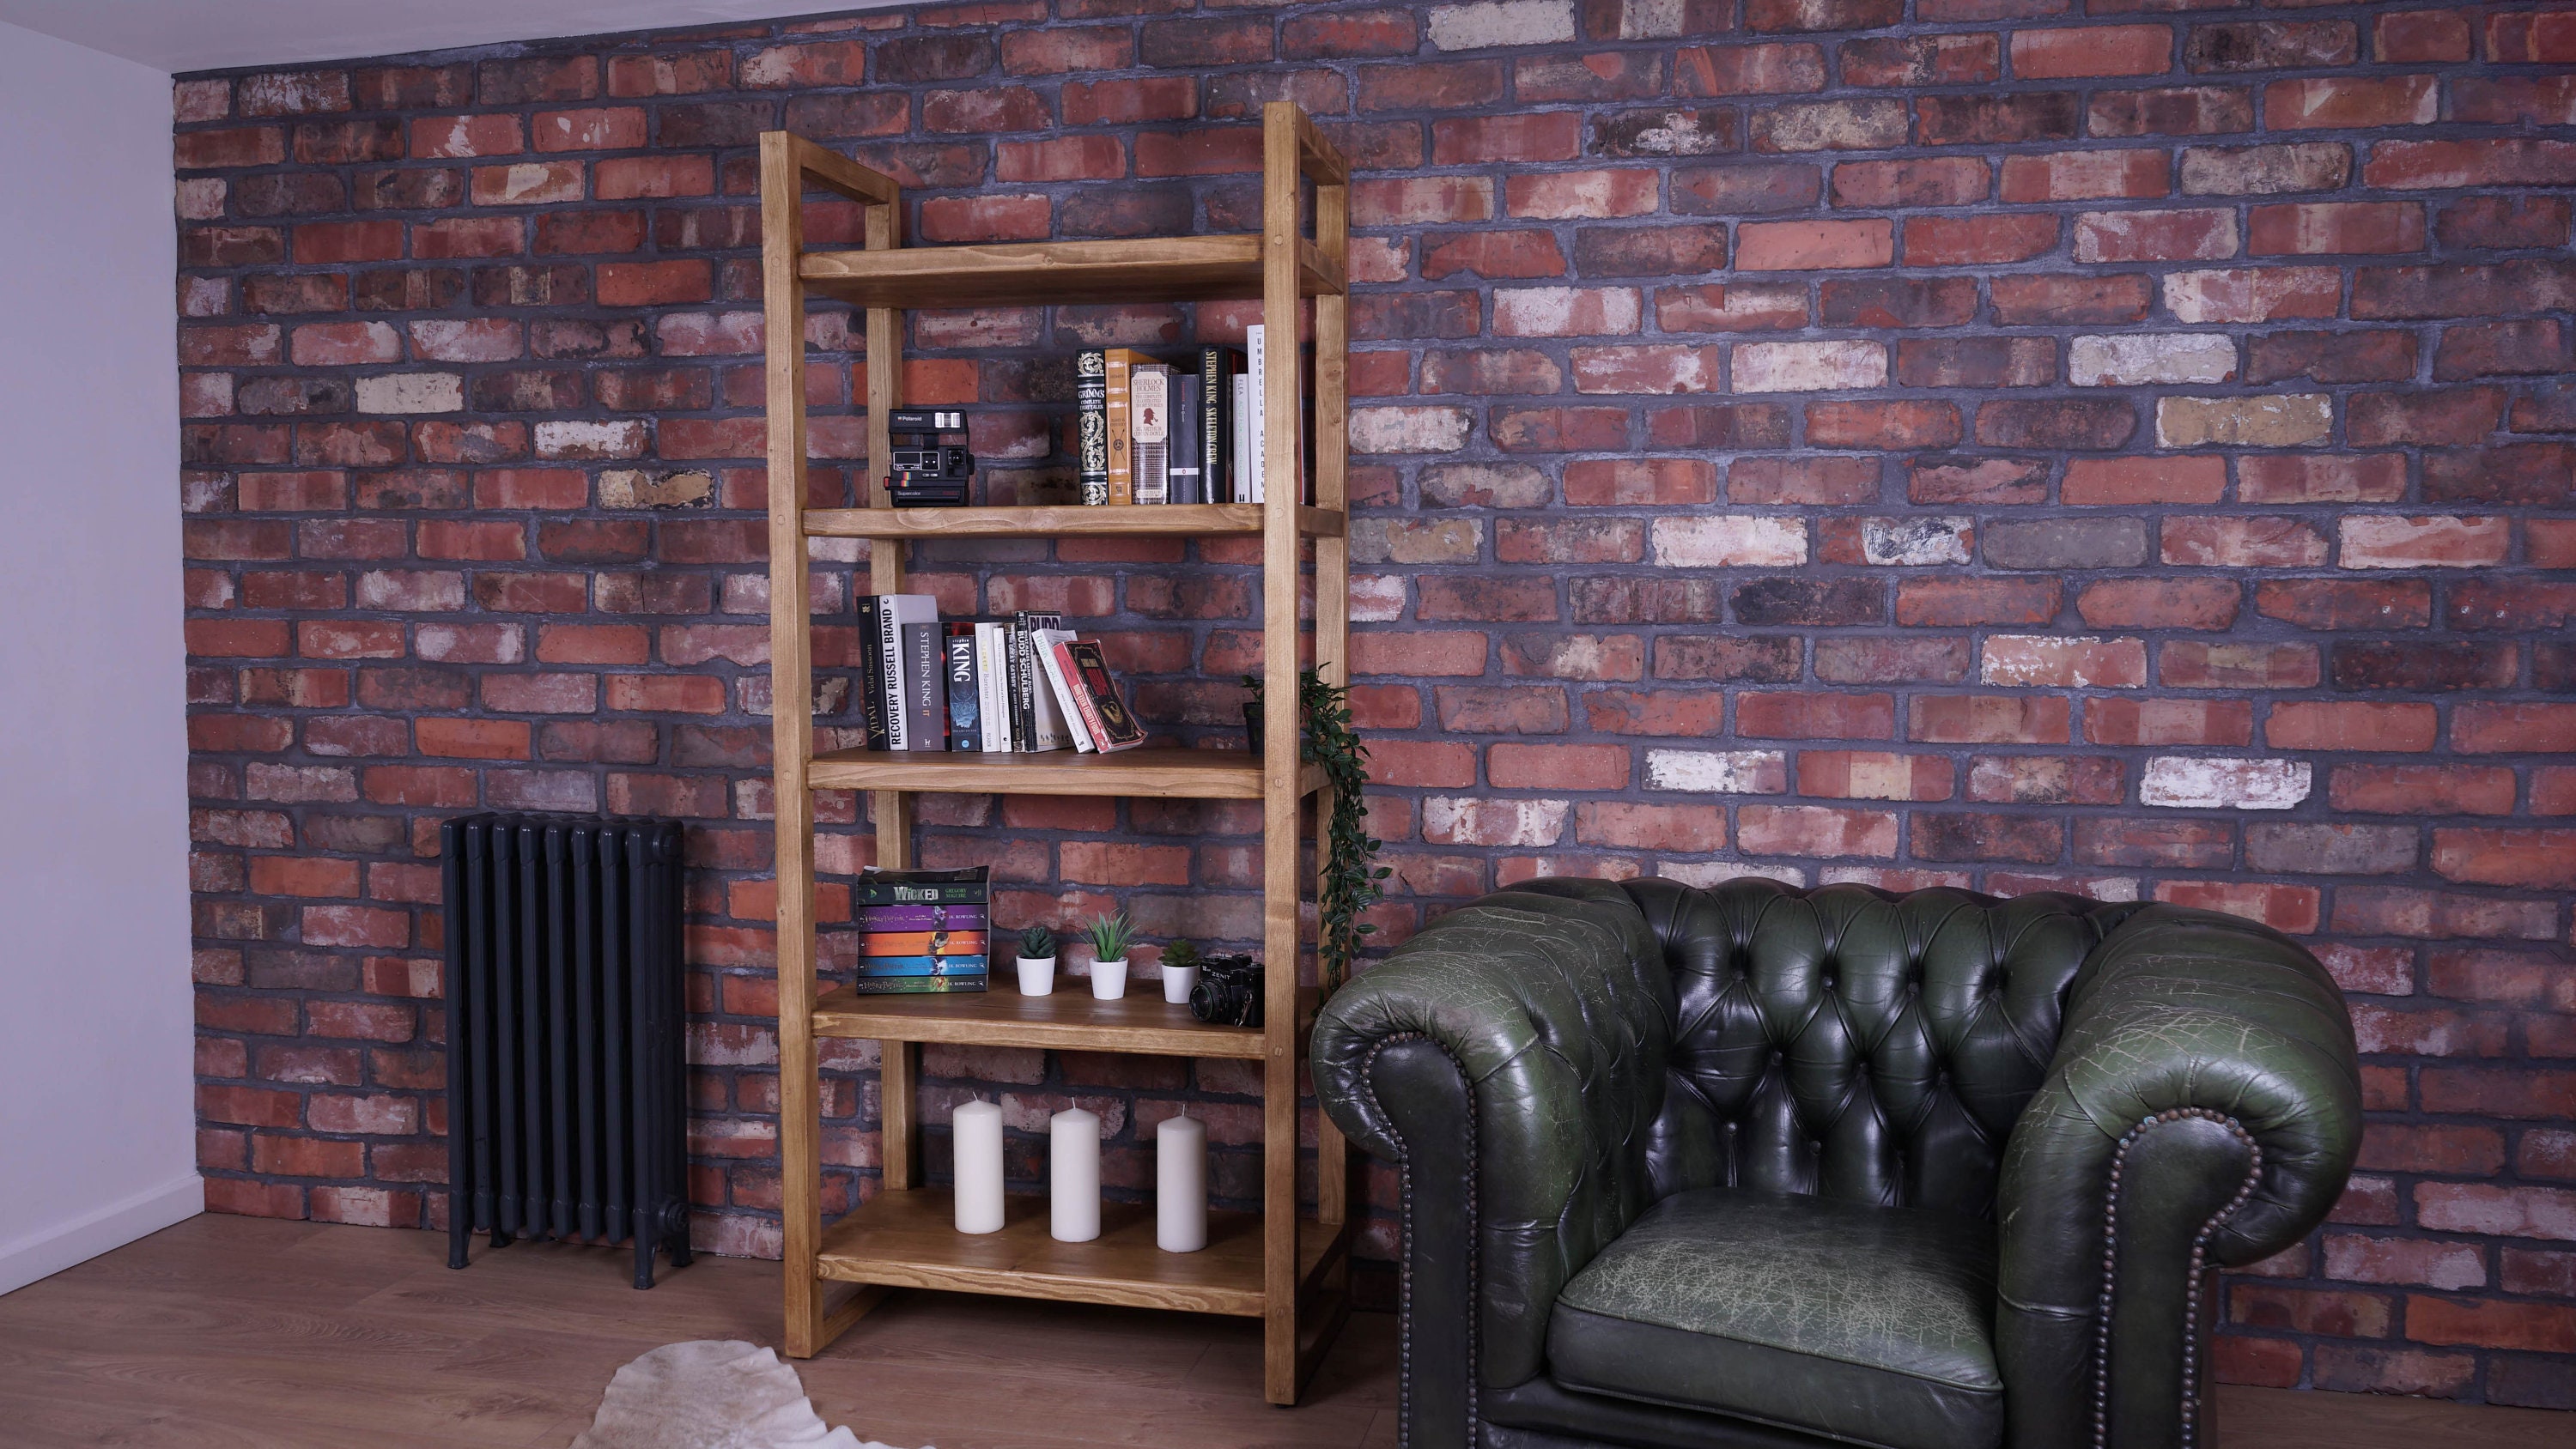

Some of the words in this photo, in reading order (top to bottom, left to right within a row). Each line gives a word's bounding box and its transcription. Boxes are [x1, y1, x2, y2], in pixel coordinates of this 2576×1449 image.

[1206, 351, 1218, 385] STEPHEN
[1206, 385, 1218, 404] KING
[1206, 407, 1218, 444] SKELETON
[1206, 444, 1218, 464] CREW
[882, 609, 895, 644] BRAND
[1017, 630, 1025, 656] BUDD
[884, 646, 898, 690] RUSSELL
[920, 632, 930, 678] STEPHEN
[952, 642, 971, 683] KING
[921, 680, 932, 706] KING
[1019, 658, 1030, 710] SCHULBERG
[867, 701, 885, 739] VIDAL
[888, 693, 902, 745] RECOVERY
[1212, 971, 1230, 980] ZENIT
